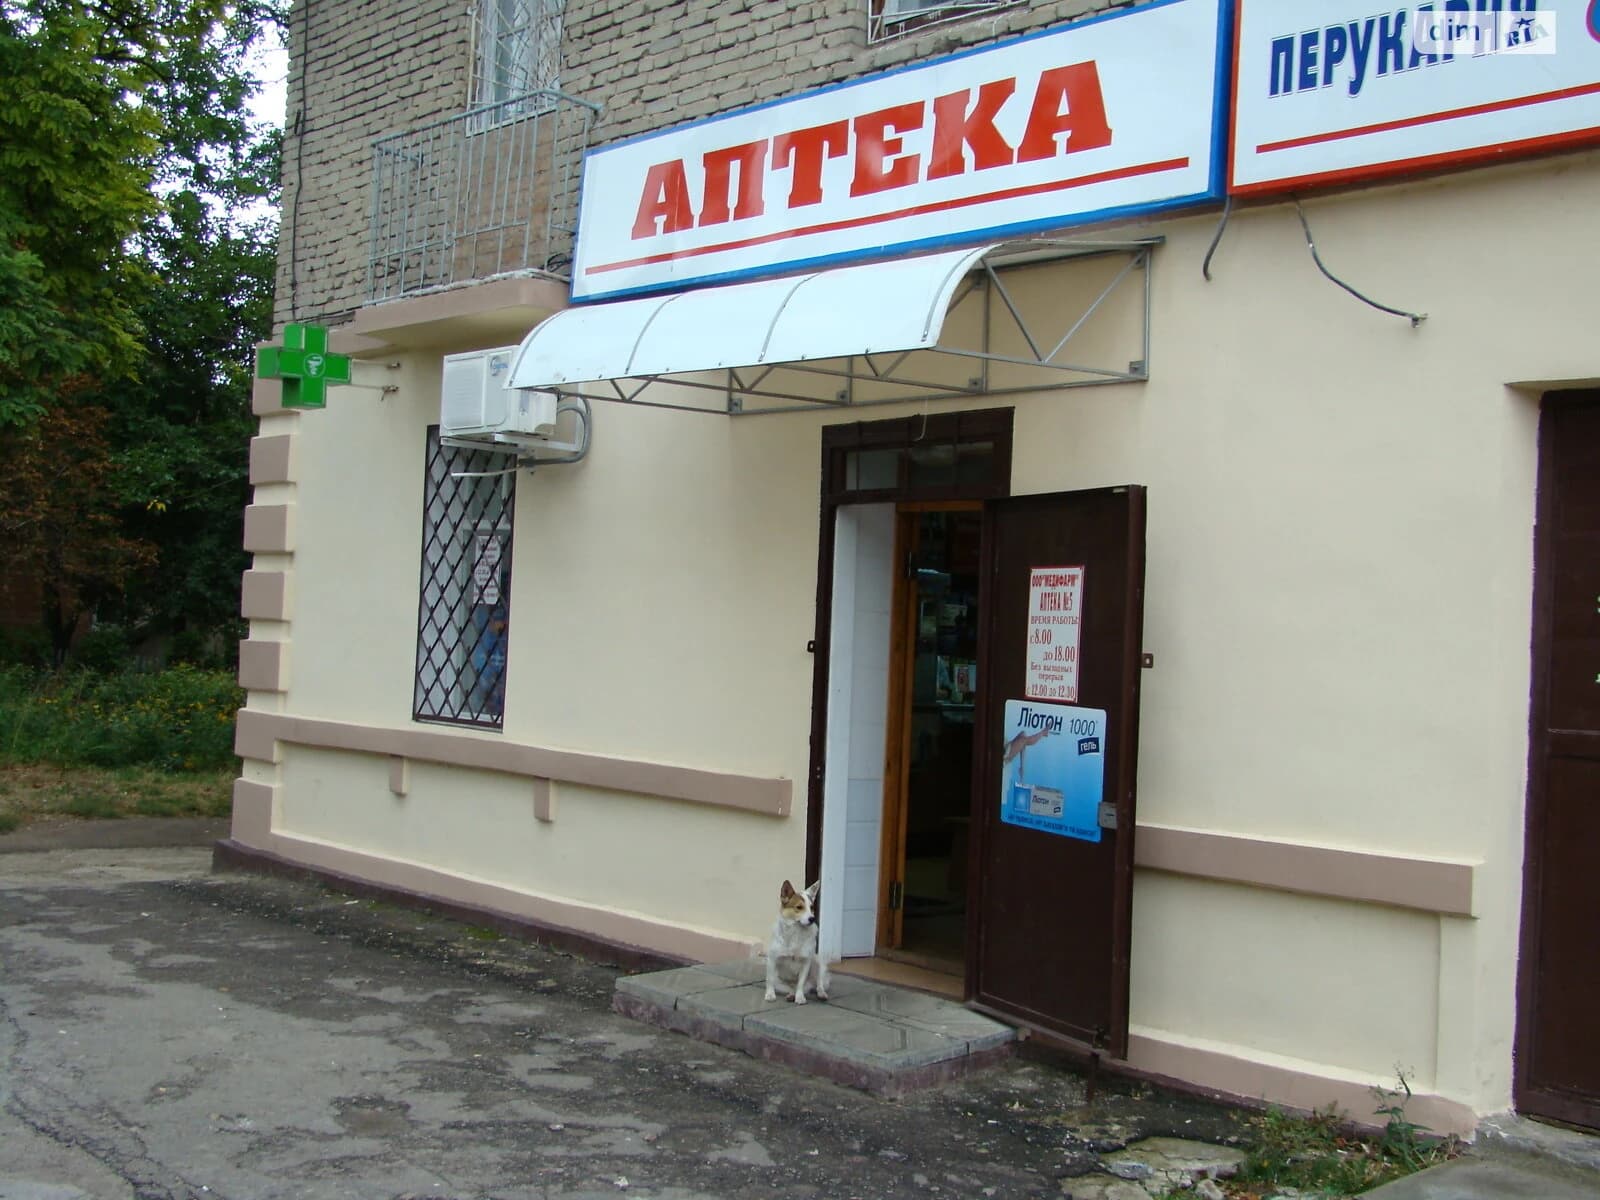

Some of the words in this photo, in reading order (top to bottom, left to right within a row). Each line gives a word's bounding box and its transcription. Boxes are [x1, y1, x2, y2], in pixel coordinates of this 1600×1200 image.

[631, 59, 1113, 240] АПТЕКА
[1040, 591, 1061, 611] АПТЕКА
[1031, 615, 1051, 625] ВРЕМЯ
[1054, 646, 1075, 662] 18.00
[1017, 707, 1063, 732] Ліотон
[1080, 741, 1097, 752] гель
